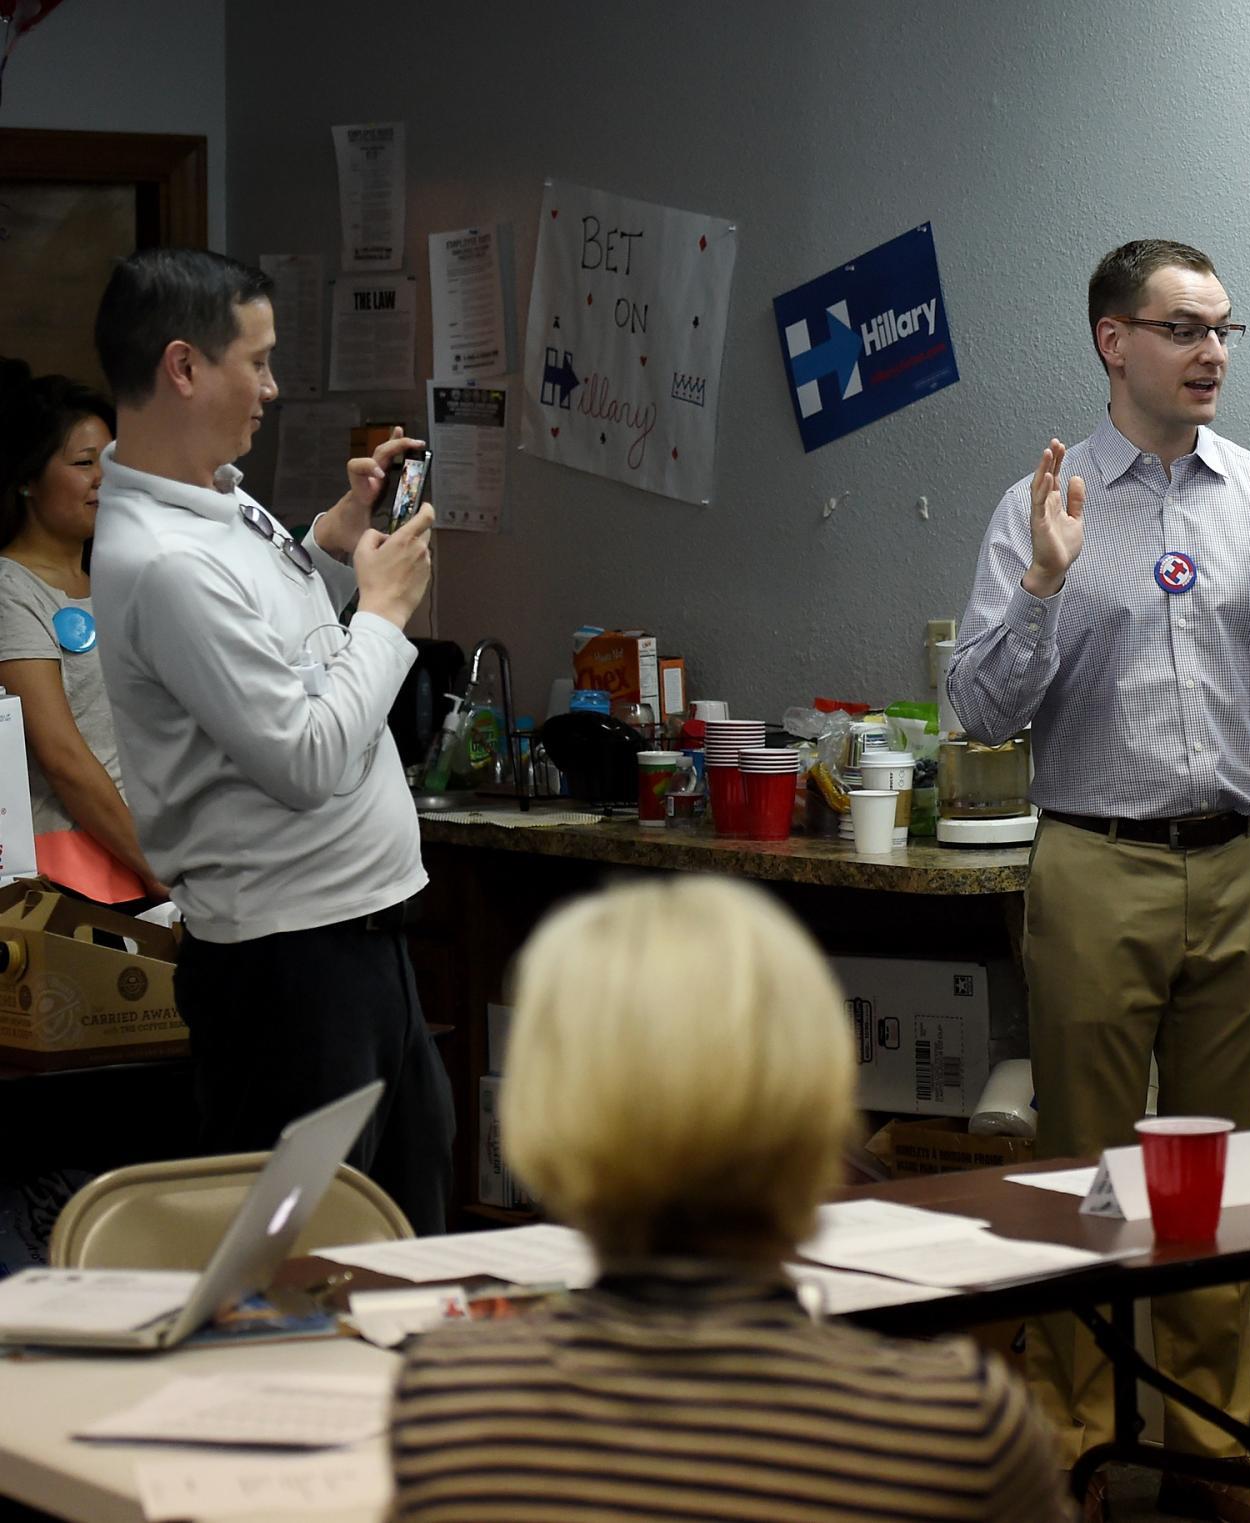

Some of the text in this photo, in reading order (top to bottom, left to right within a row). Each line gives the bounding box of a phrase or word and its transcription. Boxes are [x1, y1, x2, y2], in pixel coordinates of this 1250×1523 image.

[581, 215, 645, 276] BET
[353, 290, 396, 311] THE LAW
[614, 298, 649, 335] ON
[859, 296, 937, 358] Hillary
[81, 1007, 179, 1026] CARRIED AWAY
